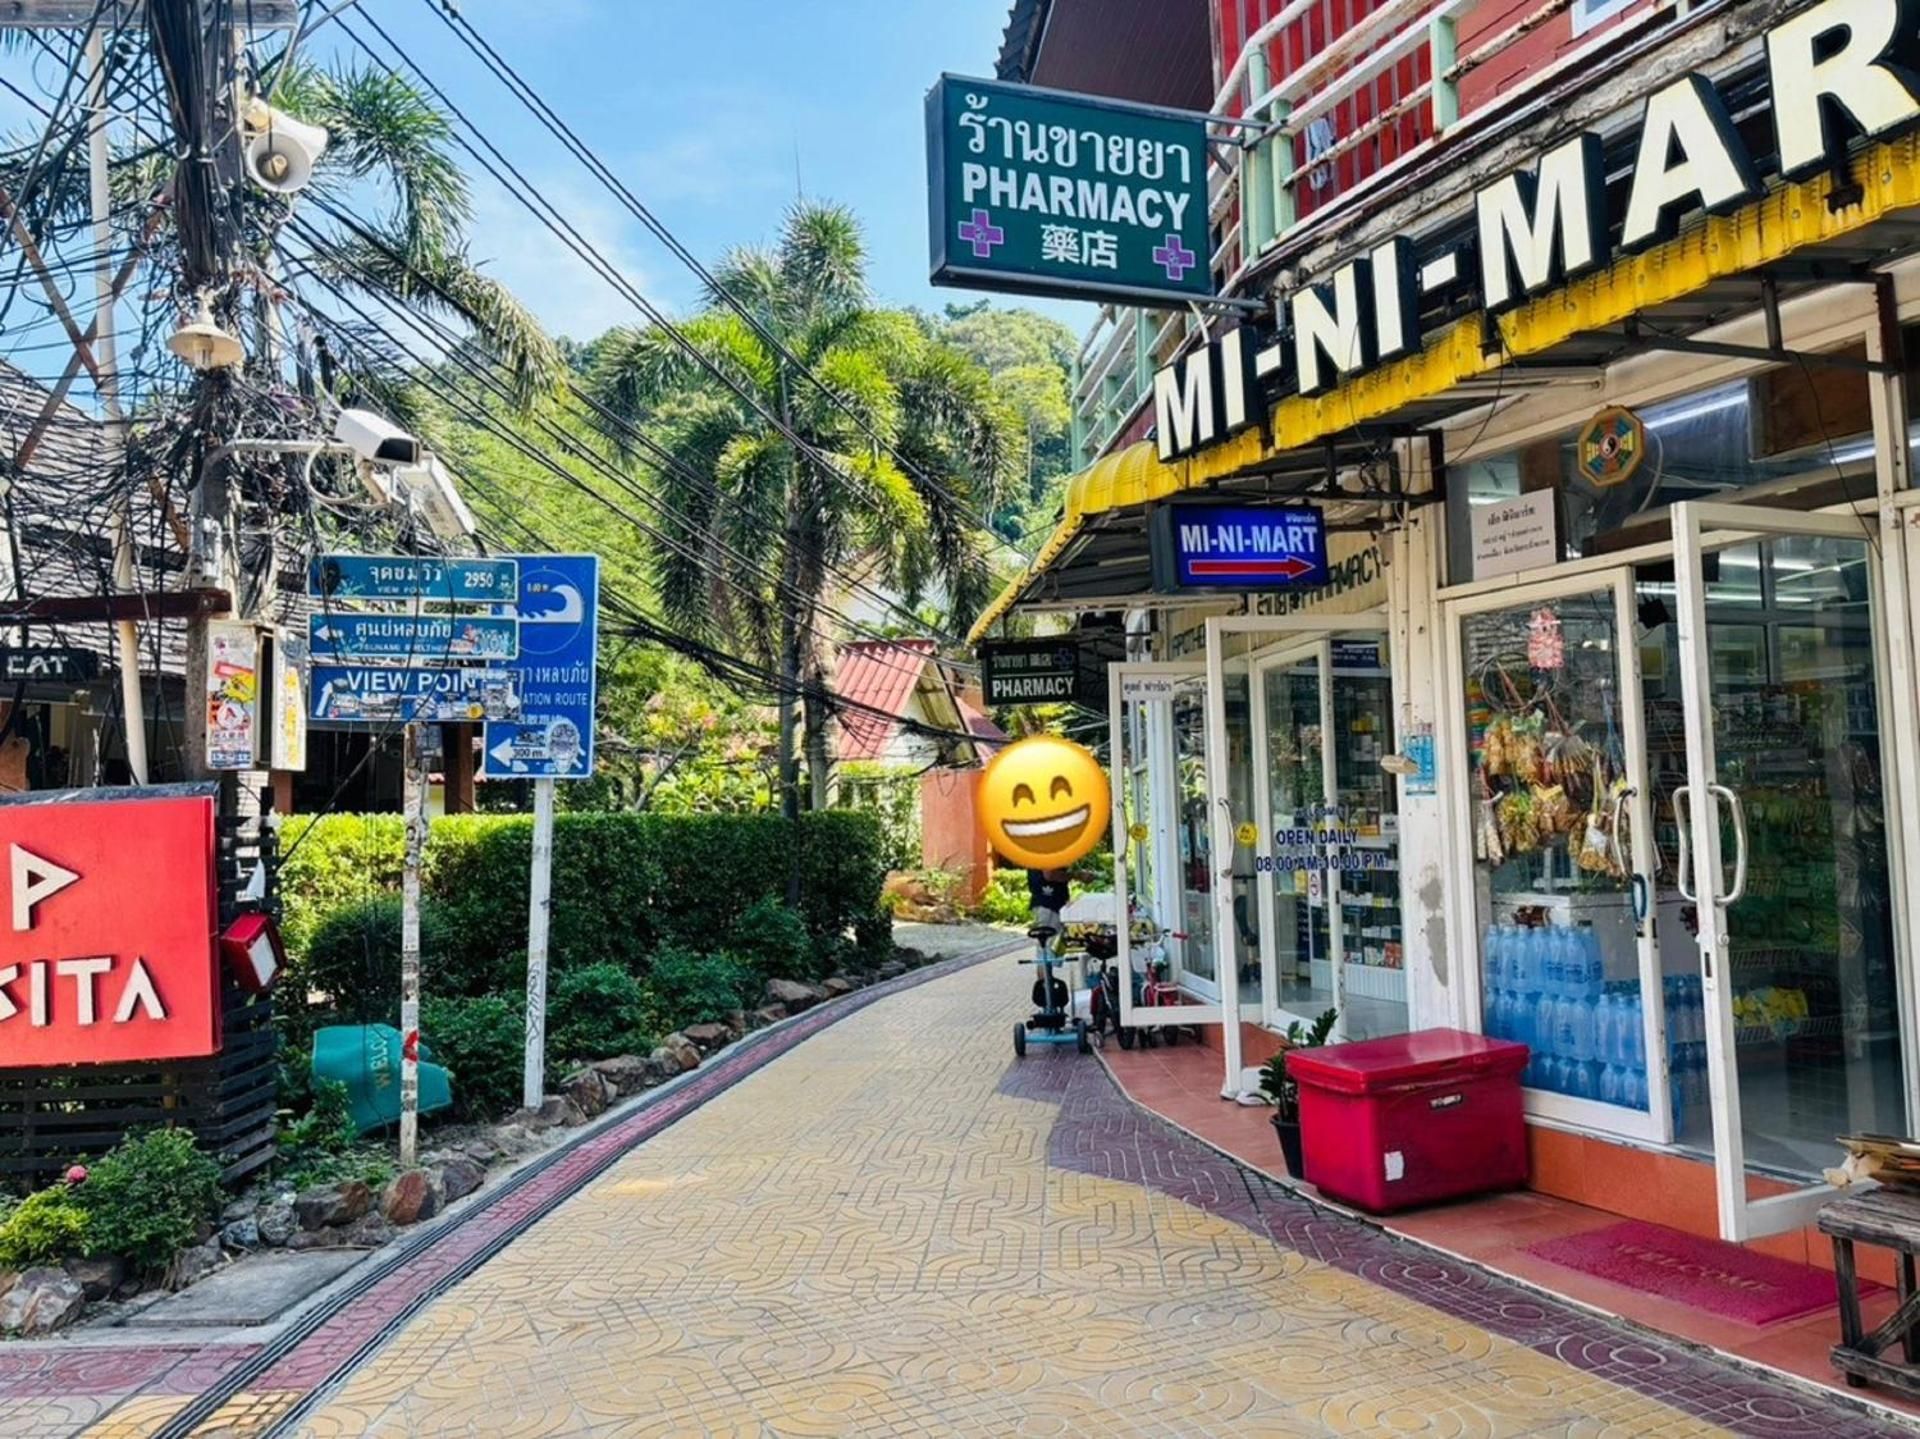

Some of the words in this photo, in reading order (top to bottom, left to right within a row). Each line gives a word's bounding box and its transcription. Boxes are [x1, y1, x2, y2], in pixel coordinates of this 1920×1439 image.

[958, 93, 1191, 184] ร้านขายยา
[961, 161, 1192, 232] PHARMACY
[1039, 223, 1119, 270] 藥店
[1180, 524, 1318, 553] MI-NI-MART
[463, 571, 494, 588] 2950
[346, 670, 411, 692] VIEW
[418, 672, 477, 693] POIN
[992, 676, 1075, 698] PHARMACY
[554, 692, 589, 706] ROUTE
[1275, 830, 1315, 846] OPEN
[1319, 828, 1359, 845] DAILY
[1255, 855, 1294, 873] 08.00
[10, 842, 82, 932] P
